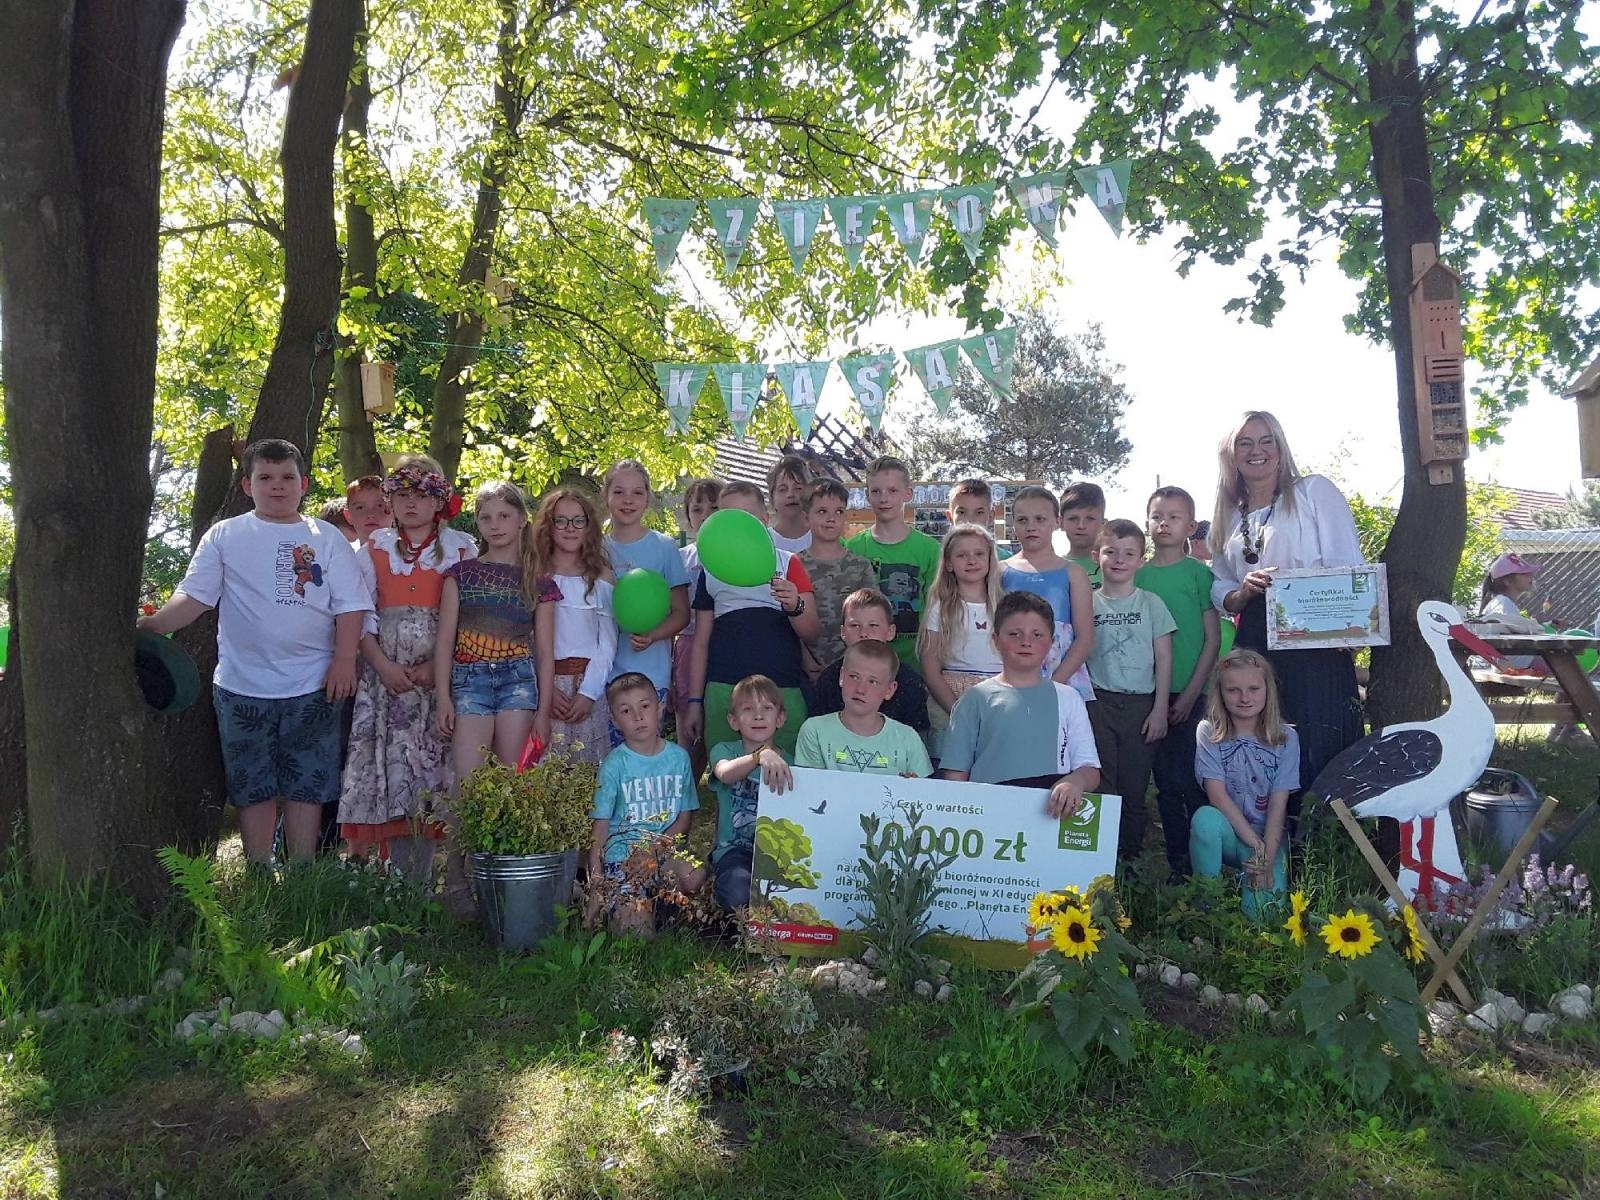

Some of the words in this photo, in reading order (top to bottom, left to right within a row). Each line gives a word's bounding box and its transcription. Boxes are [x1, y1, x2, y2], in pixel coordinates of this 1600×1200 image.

[724, 168, 1124, 248] ZIELONA
[667, 336, 1003, 412] KLASA!
[275, 540, 297, 597] NARUTO
[1092, 618, 1142, 628] EXPEDITION
[621, 775, 683, 804] VENICE
[897, 799, 923, 810] Czek
[926, 803, 933, 811] o
[936, 804, 984, 815] wartości
[993, 831, 1028, 863] zł
[835, 876, 852, 886] dla
[980, 889, 989, 897] w
[992, 889, 1004, 898] XI
[837, 864, 850, 873] na
[944, 870, 1040, 888] bioróżnorodności
